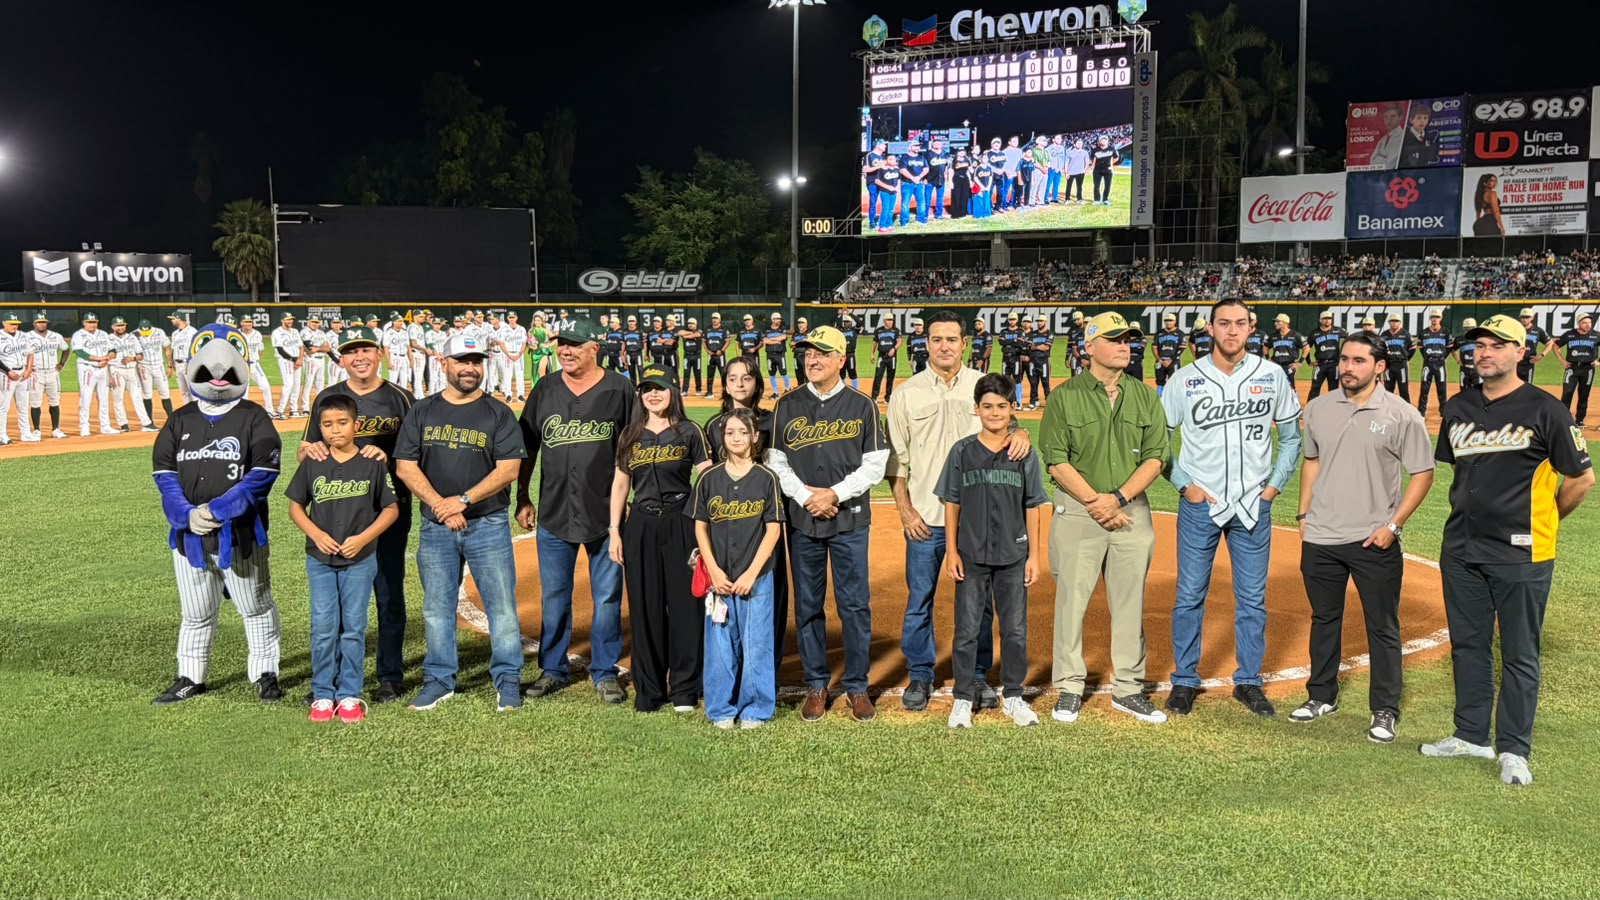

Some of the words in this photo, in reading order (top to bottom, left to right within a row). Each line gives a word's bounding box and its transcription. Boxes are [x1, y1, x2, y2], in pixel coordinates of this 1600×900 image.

[950, 4, 1110, 41] Chevron
[1030, 50, 1037, 58] C
[1047, 49, 1055, 57] H
[1065, 47, 1072, 55] E
[935, 60, 942, 68] 3
[950, 59, 956, 67] 4
[961, 58, 967, 66] 5
[973, 57, 979, 65] 6
[988, 55, 995, 63] 7
[1000, 54, 1006, 62] 8
[1086, 60, 1094, 70] B
[1102, 58, 1111, 68] S
[1140, 59, 1152, 83] cpe
[1362, 107, 1378, 115] UAD
[1443, 100, 1461, 109] CID
[1532, 97, 1585, 119] 98.9
[1429, 118, 1462, 127] ABIERTAS
[1139, 132, 1149, 142] tu
[1350, 135, 1375, 143] LOBOS
[1524, 130, 1564, 142] Línea
[1139, 145, 1148, 155] de
[1523, 143, 1580, 157] Directa
[1139, 158, 1151, 186] imagen
[1503, 183, 1528, 193] HAZLE
[1530, 183, 1540, 192] UN
[1542, 181, 1567, 190] HOME
[1569, 180, 1585, 190] RUN
[1503, 194, 1508, 204] A
[1510, 193, 1525, 203] TUS
[1527, 192, 1564, 203] EXCUSAS
[1248, 191, 1339, 224] Coca-Cola
[804, 219, 831, 233] 0:00
[1358, 214, 1444, 230] Banamex
[80, 260, 184, 282] Chevron
[253, 313, 270, 327] 29
[643, 314, 650, 327] 3
[1188, 377, 1206, 389] cpe
[1192, 396, 1274, 430] Cañeros
[357, 415, 400, 435] ñeros
[542, 414, 614, 448] Cañeros
[1245, 424, 1264, 441] 72
[423, 424, 487, 448] CAÑEROS
[783, 416, 863, 450] Cañeros
[1449, 422, 1534, 457] Mochis
[185, 447, 241, 461] colorado
[227, 463, 245, 480] 31
[981, 469, 1022, 487] MOCHIS
[312, 476, 371, 503] Cañeros
[707, 496, 765, 523] Cañeros
